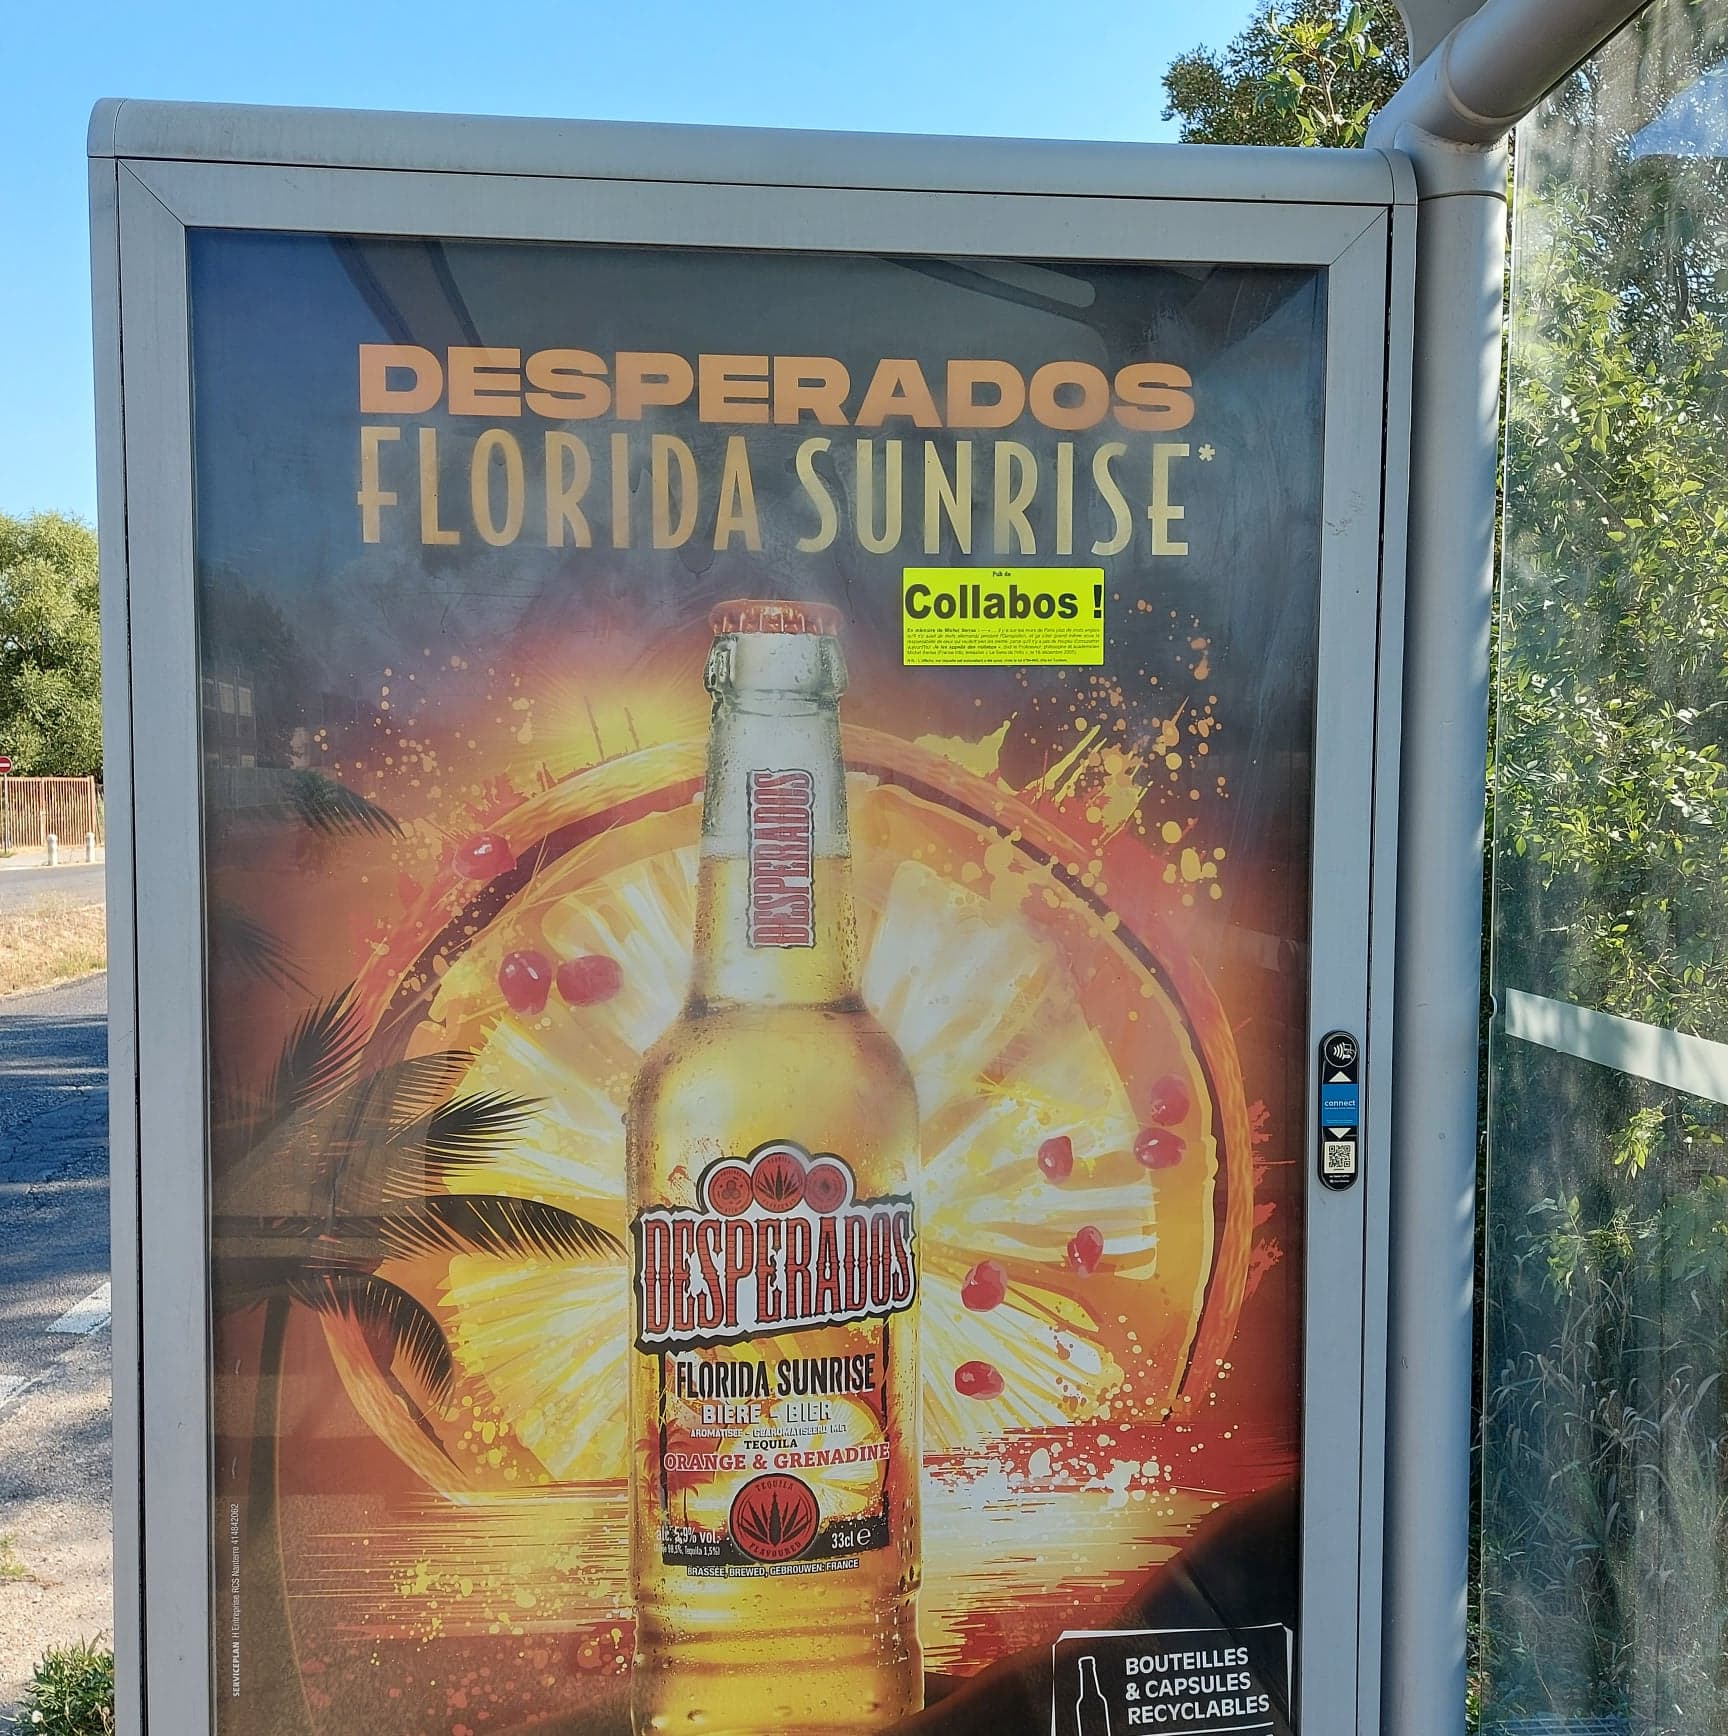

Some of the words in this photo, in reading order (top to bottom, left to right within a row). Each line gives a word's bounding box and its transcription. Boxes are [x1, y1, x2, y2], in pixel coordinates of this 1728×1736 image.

[359, 343, 1196, 432] DESPERADOS
[357, 426, 762, 552] FLORIDA
[905, 583, 1079, 620] Collabos
[1093, 584, 1102, 619] !
[753, 773, 810, 944] DESPERADOS
[643, 1211, 915, 1334] DESPERADOS
[676, 1360, 770, 1398] FLORIDA
[777, 1353, 876, 1397] SUNRISE
[702, 1400, 761, 1424] BIÈRE
[786, 1401, 833, 1423] BIER
[663, 1453, 746, 1471] ORANGE
[752, 1454, 767, 1470] &
[773, 1443, 890, 1469] GRENADINE
[744, 1439, 798, 1450] TEQUILA
[755, 1480, 793, 1492] TEQUILA
[749, 1541, 802, 1557] FLAVOURED
[831, 1530, 854, 1549] 33cl
[232, 1546, 240, 1577] Nanterre
[729, 1567, 768, 1578] BREWED,
[770, 1563, 825, 1575] GEBROUWEN:
[826, 1559, 859, 1571] FRANCE
[232, 1578, 240, 1593] RCS
[232, 1594, 241, 1631] Entreprise
[232, 1641, 240, 1697] SERVICEPLAN
[1125, 1647, 1249, 1676] BOUTEILLES
[1125, 1682, 1140, 1701] &
[1145, 1671, 1251, 1698] CAPSULES
[1127, 1694, 1270, 1726] RECYCLABLES
